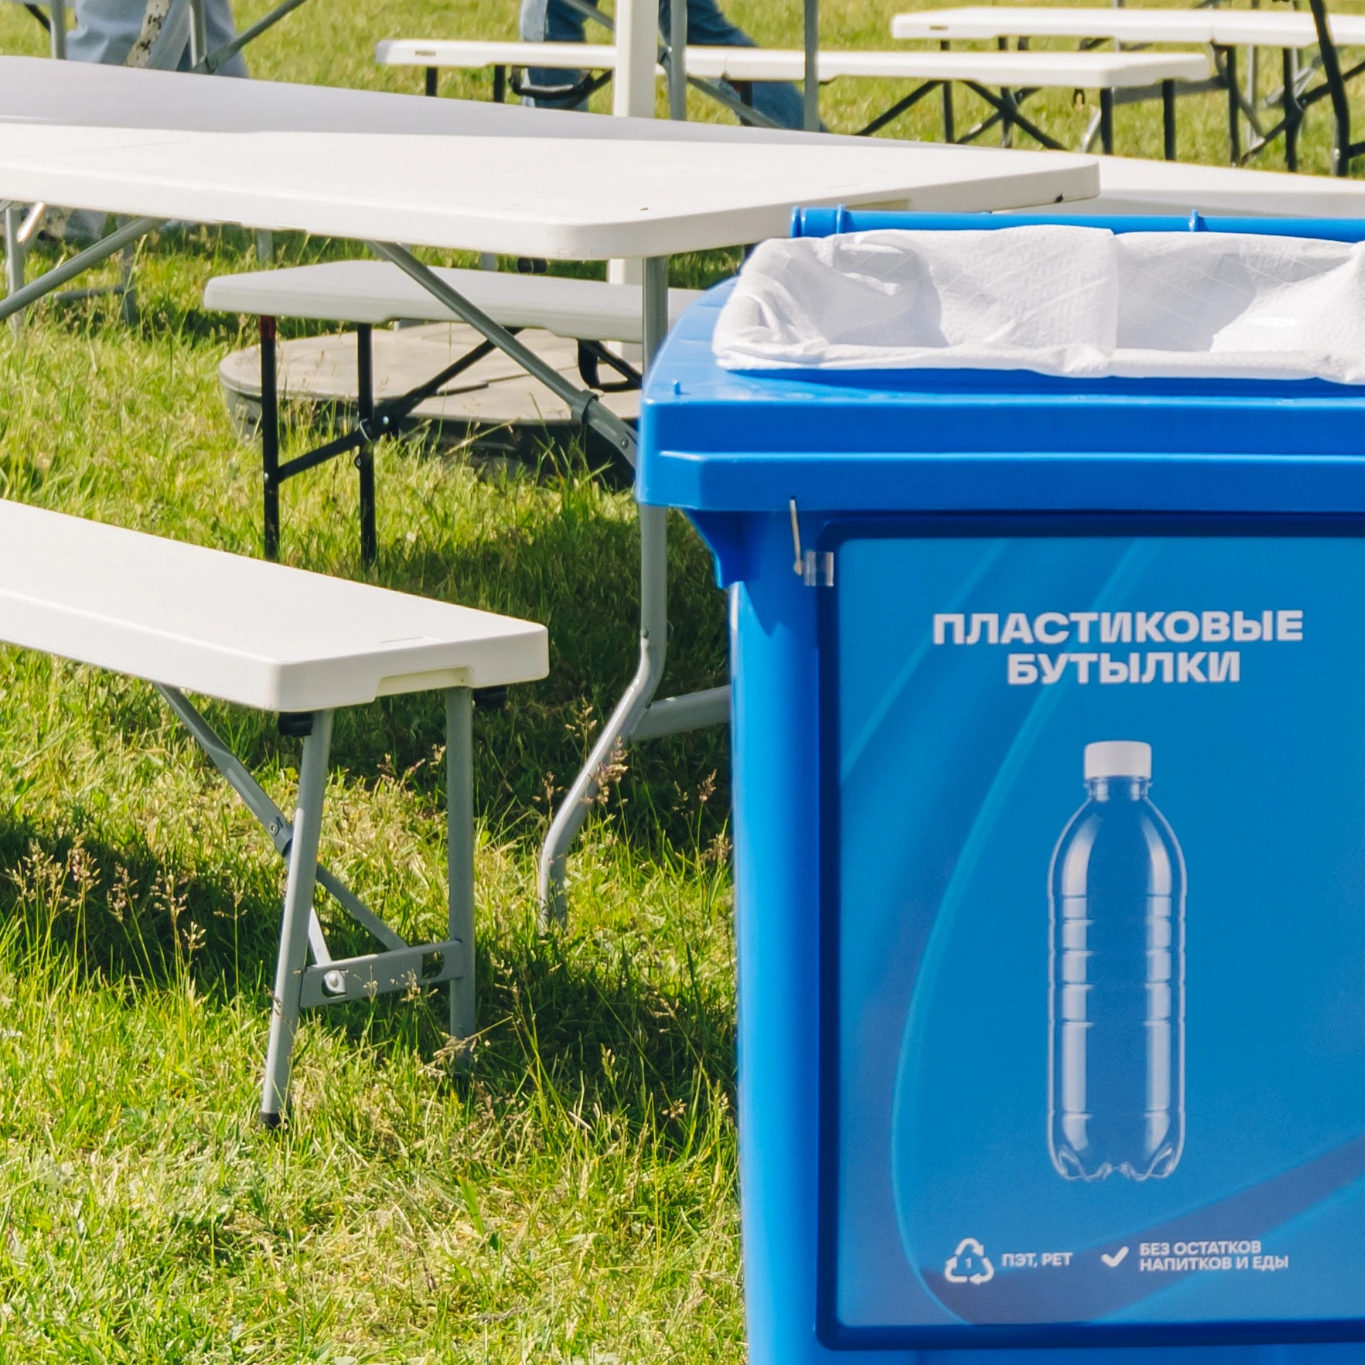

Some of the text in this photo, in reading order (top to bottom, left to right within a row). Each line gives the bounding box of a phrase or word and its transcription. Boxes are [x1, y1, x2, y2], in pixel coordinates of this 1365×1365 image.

[932, 610, 1303, 645] ПЛАСТИКОВЫЕ
[1006, 651, 1241, 685] БУТЫЛКИ
[1139, 1240, 1262, 1256] БЕЗ ОСТАТКОВ
[965, 1257, 972, 1269] 1
[1001, 1252, 1073, 1268] ПЭТ, PET
[1139, 1255, 1289, 1271] НАПИТКОВ И ЕДЫ
